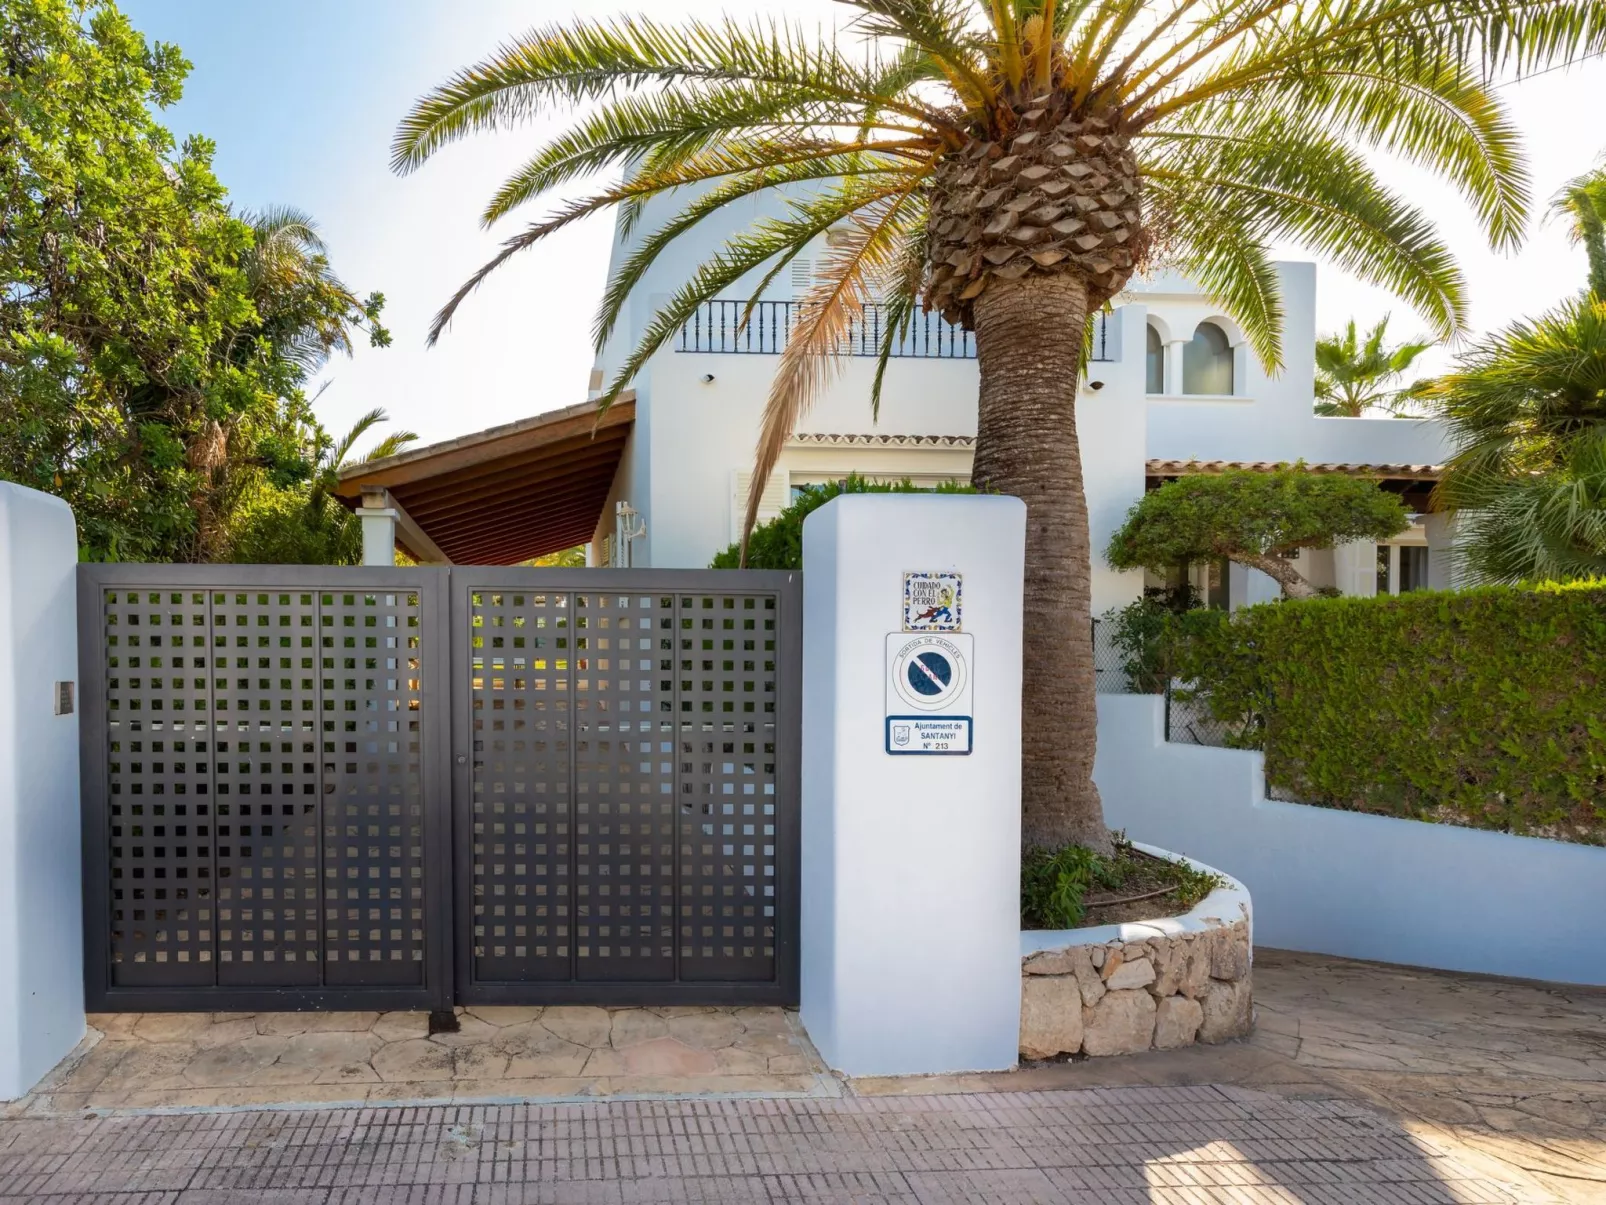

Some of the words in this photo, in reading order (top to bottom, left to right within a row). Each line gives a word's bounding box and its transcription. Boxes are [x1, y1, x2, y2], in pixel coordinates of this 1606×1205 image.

[913, 582, 941, 590] CUIDADO
[913, 589, 926, 597] CON
[928, 589, 936, 597] EL
[913, 597, 935, 605] PERRO
[899, 640, 922, 658] SORTIDA
[936, 638, 960, 659] VEHICLES
[915, 722, 953, 730] Ajuntament
